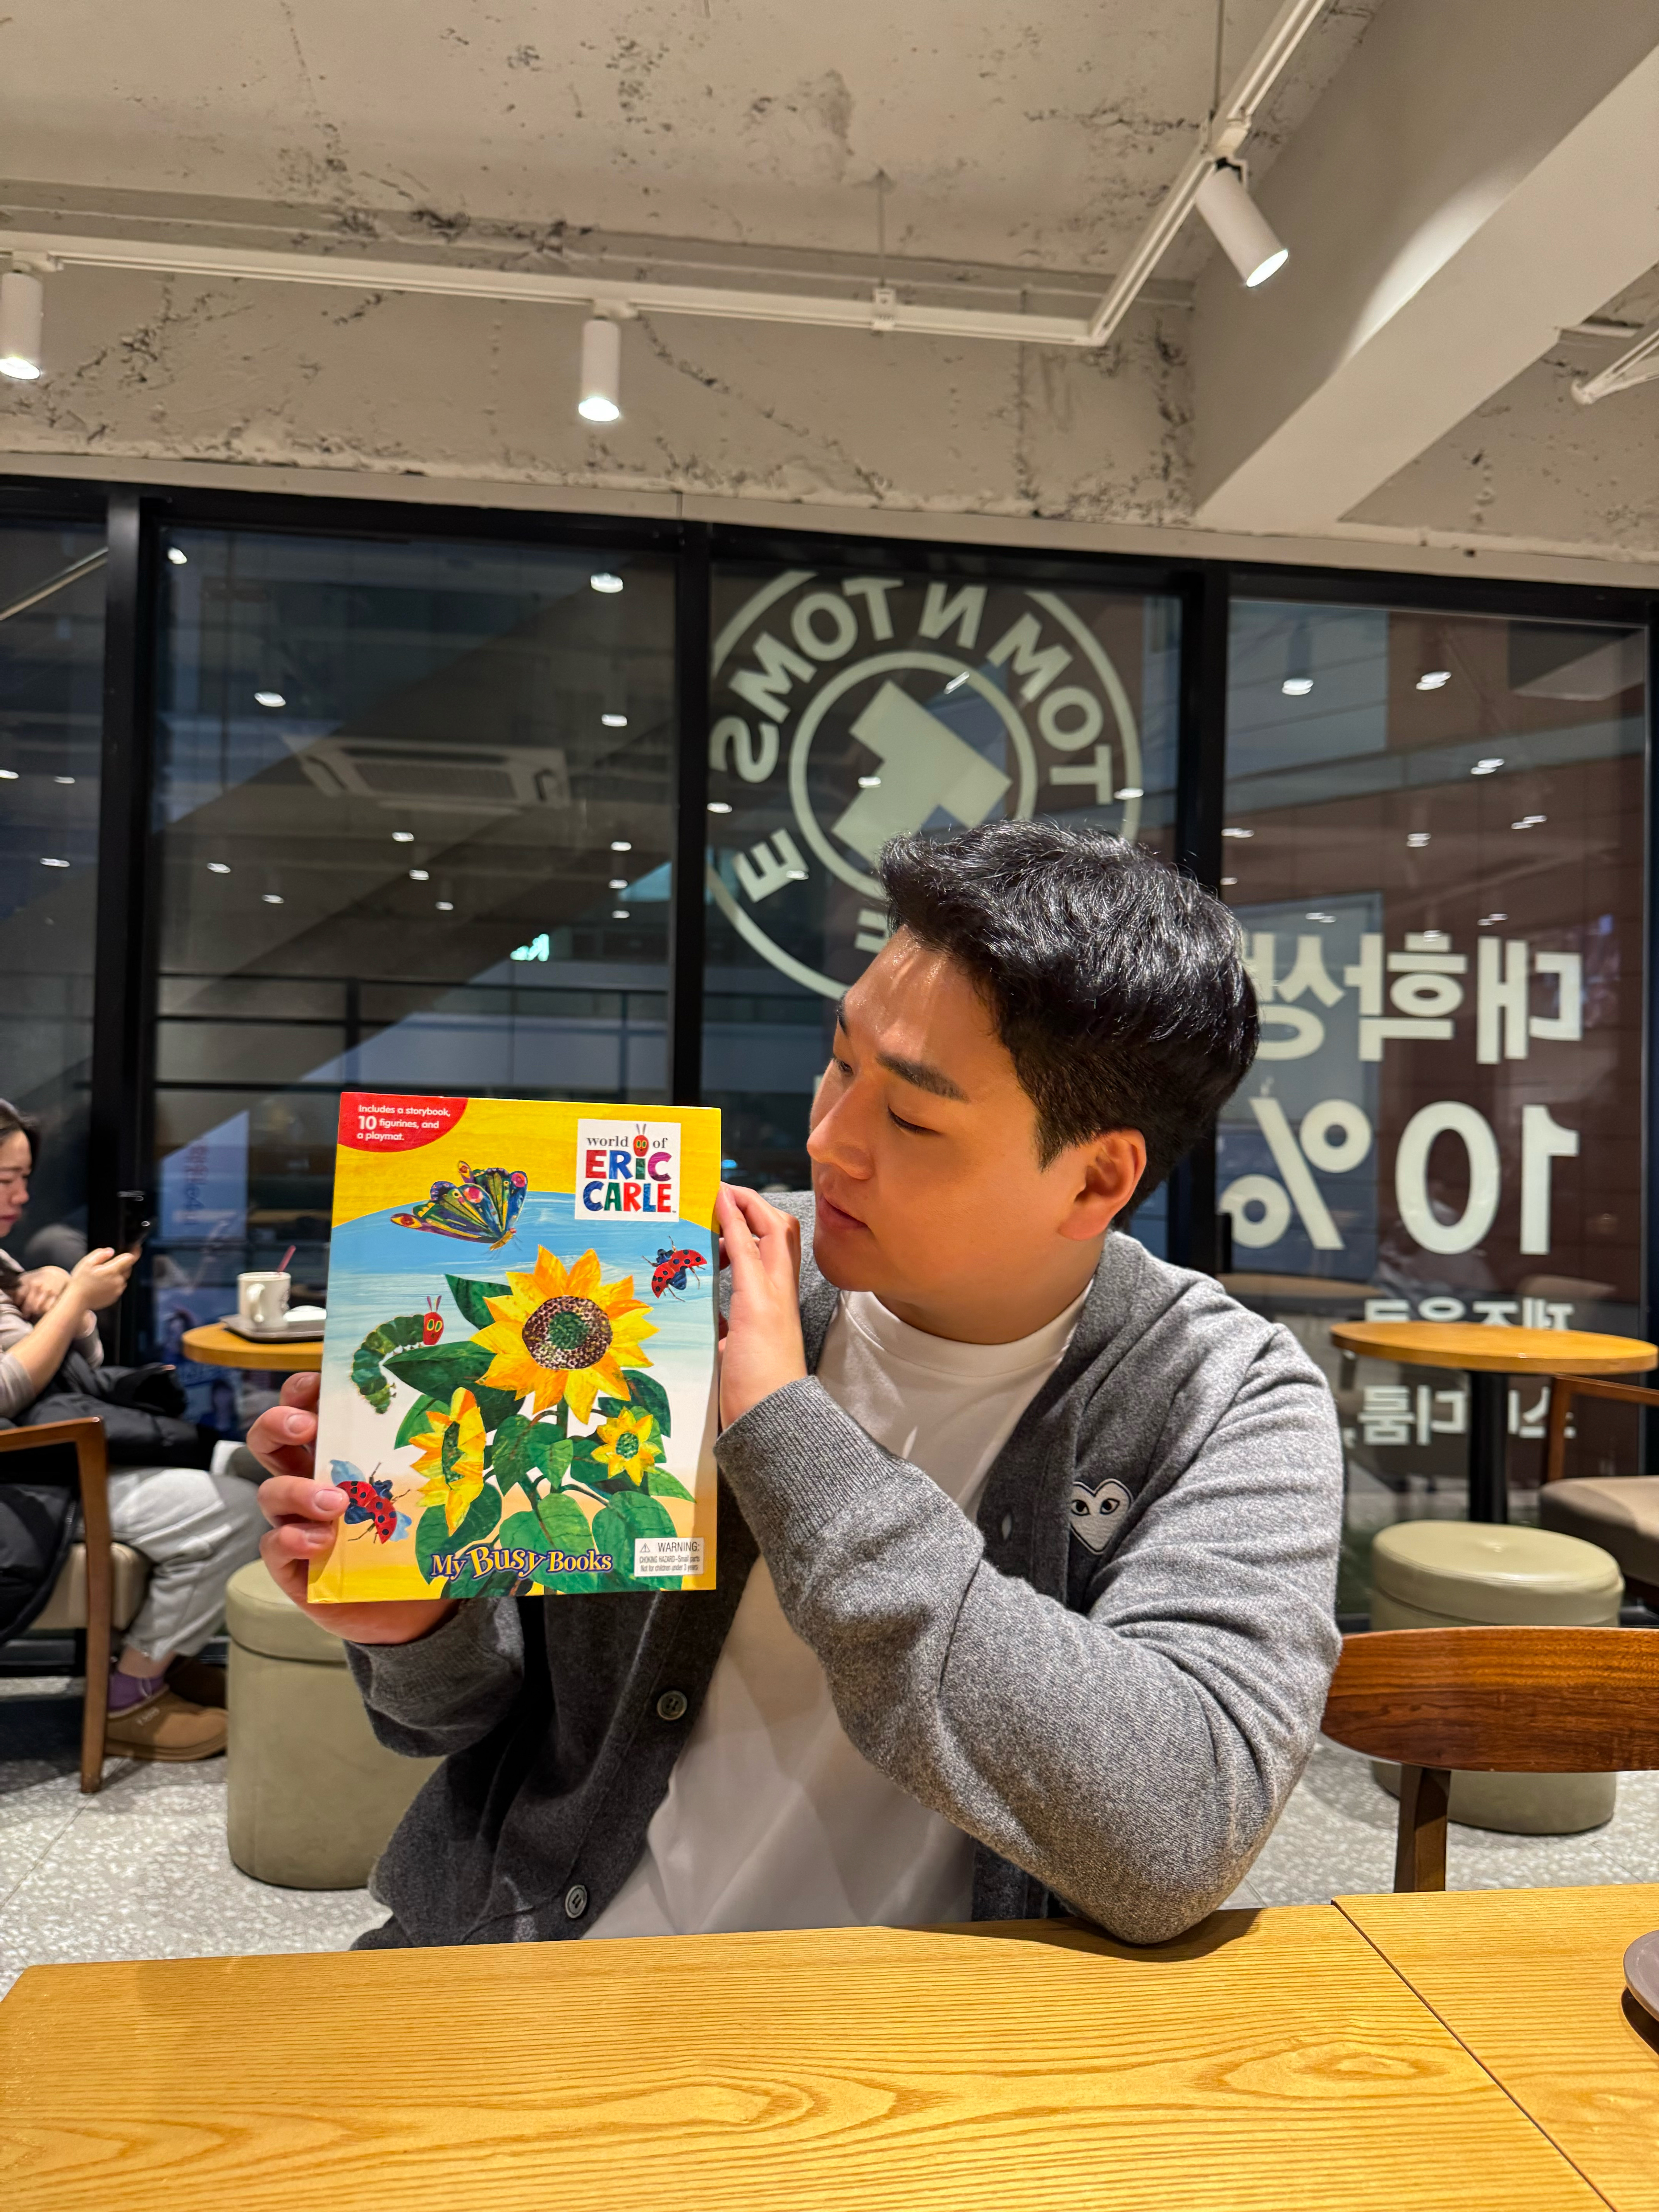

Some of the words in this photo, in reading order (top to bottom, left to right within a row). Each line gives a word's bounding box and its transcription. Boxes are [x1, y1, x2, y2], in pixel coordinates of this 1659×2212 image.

[359, 1104, 395, 1114] Includes
[405, 1107, 451, 1117] storybook,
[358, 1115, 377, 1130] 10
[379, 1118, 419, 1129] figurines,
[366, 1131, 405, 1142] playmat.
[587, 1135, 629, 1147] world
[653, 1137, 668, 1148] of
[583, 1181, 672, 1213] CARLE
[658, 1542, 700, 1553] WARNING:
[432, 1554, 466, 1581] My
[467, 1545, 545, 1578] Busy
[547, 1549, 612, 1572] Books
